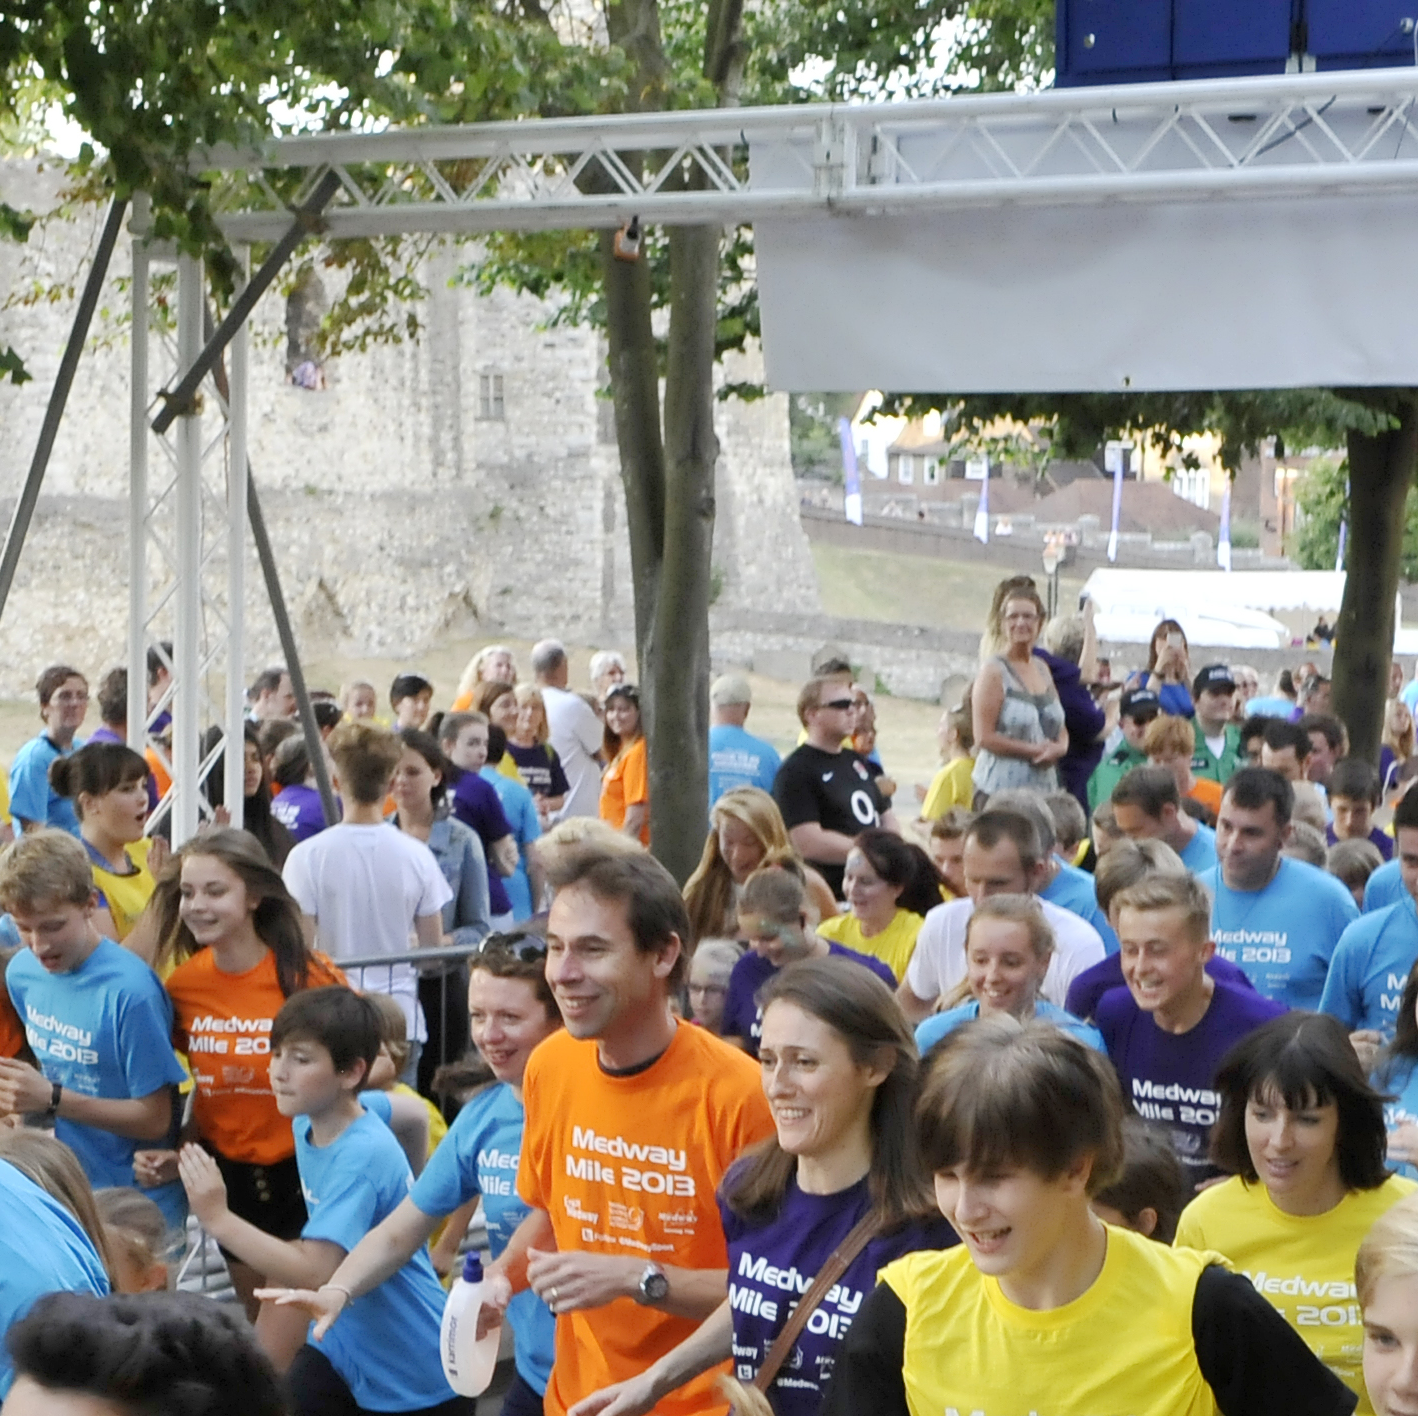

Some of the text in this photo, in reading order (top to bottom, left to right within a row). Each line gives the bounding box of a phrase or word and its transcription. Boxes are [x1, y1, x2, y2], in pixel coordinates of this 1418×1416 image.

[1242, 947, 1291, 963] 2013
[26, 1004, 92, 1047] Medway
[191, 1015, 273, 1033] Medwa
[49, 1039, 98, 1065] 2013
[188, 1035, 271, 1055] Mile 20
[1132, 1099, 1174, 1121] Mile
[572, 1125, 687, 1172] Medway
[566, 1154, 695, 1197] Mile 2013
[728, 1283, 778, 1322] Mile
